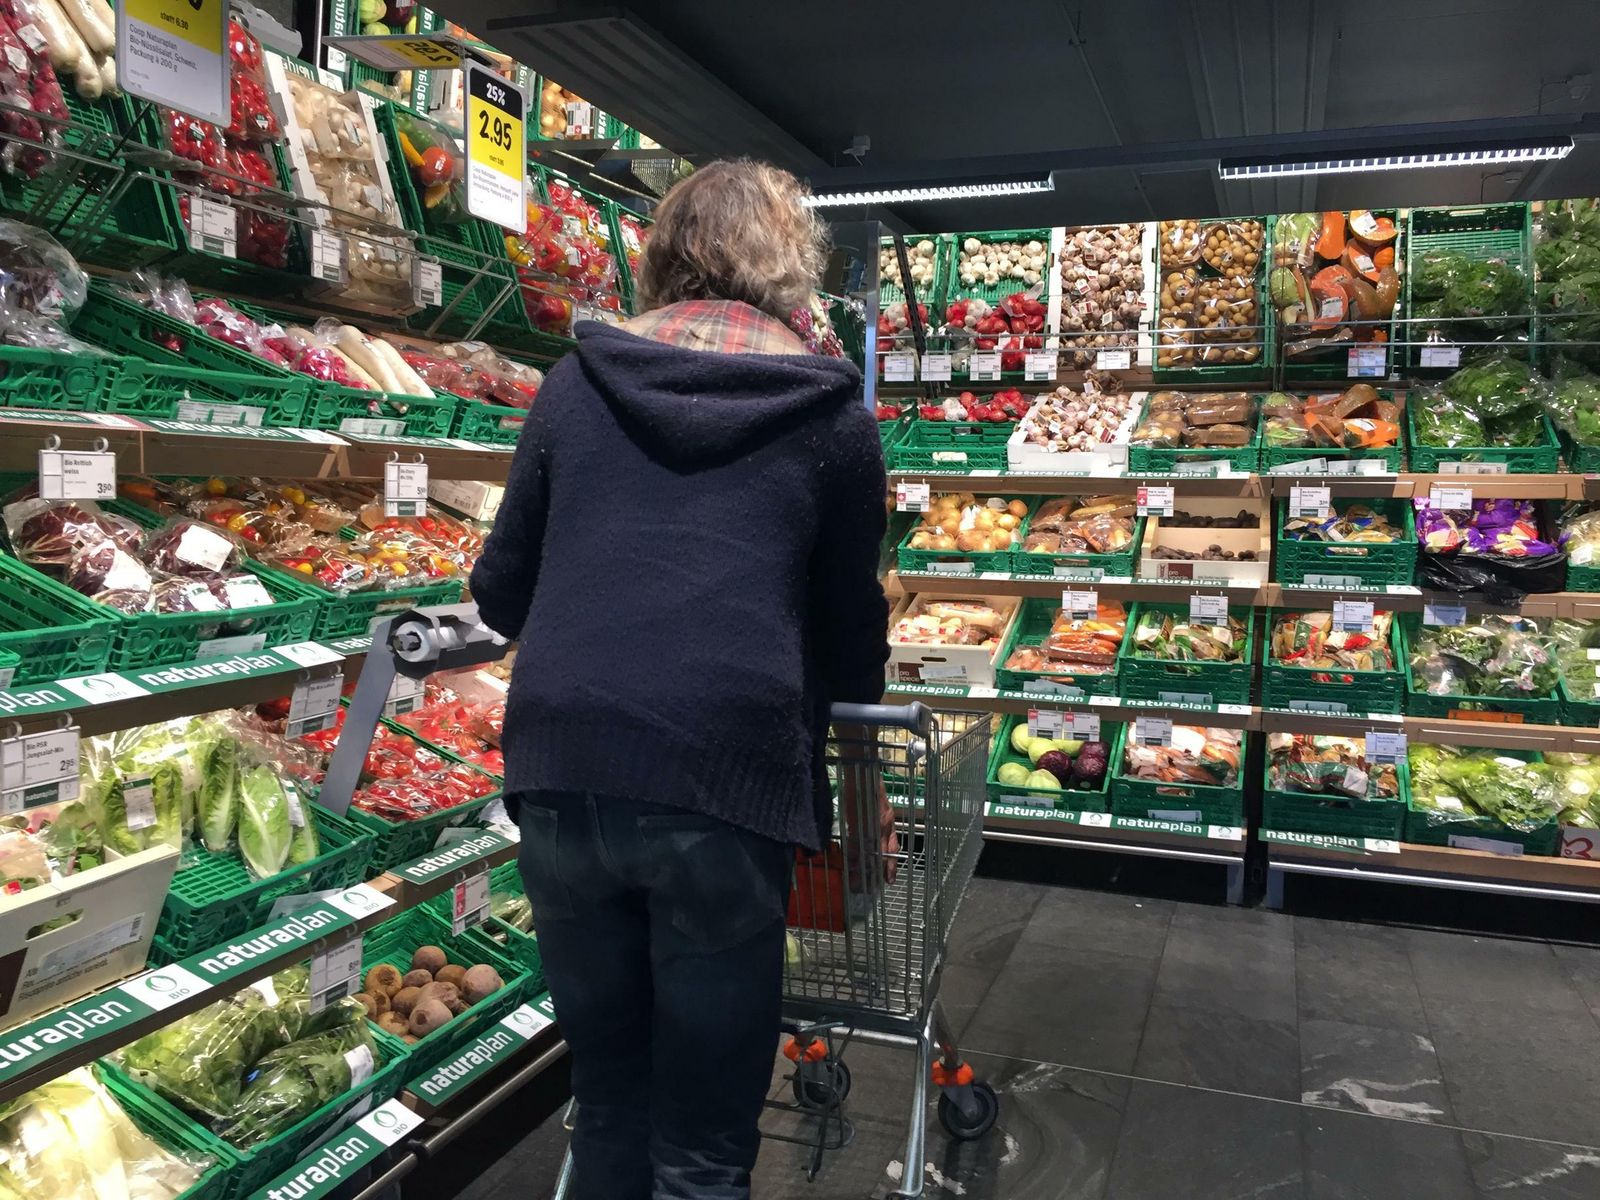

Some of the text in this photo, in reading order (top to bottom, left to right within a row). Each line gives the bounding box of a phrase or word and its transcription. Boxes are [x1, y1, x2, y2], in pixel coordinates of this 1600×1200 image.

[160, 12, 189, 30] statt 6.30
[129, 24, 177, 51] Coop Naturaplan
[130, 46, 154, 63] Packung
[160, 58, 172, 69] 200
[486, 83, 506, 106] 25%
[479, 110, 512, 151] 2.95
[149, 420, 292, 438] naturaplan
[1015, 573, 1095, 582] naturaplan
[1138, 578, 1222, 586] naturaplan
[1288, 582, 1379, 592] naturaplan
[138, 653, 284, 686] naturaplan
[887, 684, 964, 695] naturaplan
[1003, 691, 1084, 703] naturaplan
[0, 689, 67, 713] plan
[1126, 699, 1212, 711] naturaplan
[1269, 706, 1361, 717] naturaplan
[994, 804, 1075, 821] naturaplan
[1117, 817, 1202, 834] naturaplan
[405, 835, 502, 877] naturaplan
[198, 909, 339, 975] naturaplan
[168, 988, 190, 1000] BIO
[539, 1001, 554, 1013] n
[0, 999, 132, 1069] uraplan
[420, 1031, 514, 1095] naturaplan
[392, 1123, 408, 1135] BIO
[264, 1137, 370, 1200] turaplan
